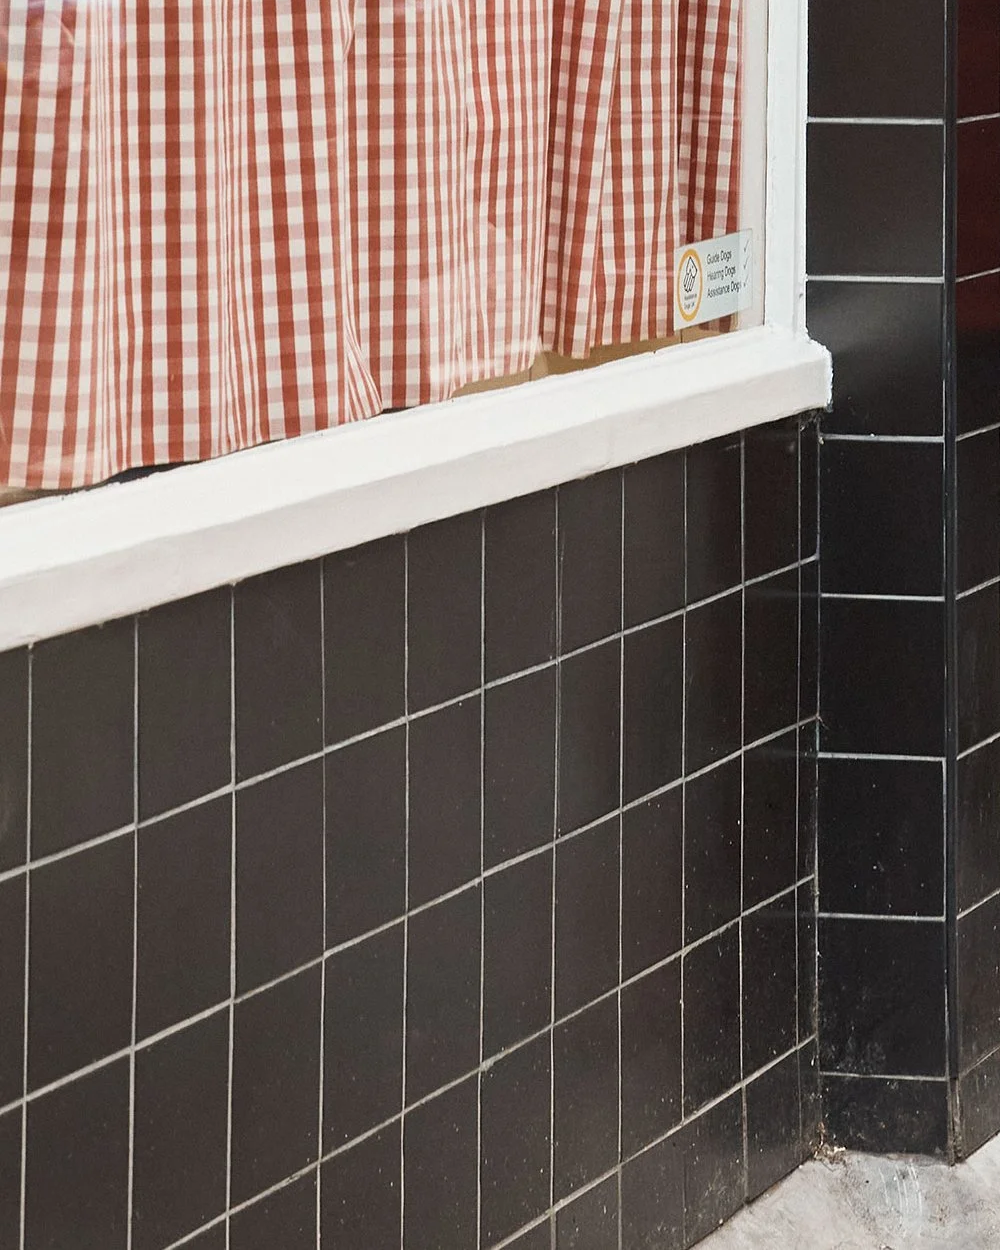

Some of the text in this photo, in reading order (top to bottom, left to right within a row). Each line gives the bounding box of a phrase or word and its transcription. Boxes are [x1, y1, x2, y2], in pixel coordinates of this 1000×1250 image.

[707, 250, 732, 264] Guide Dogs
[706, 266, 736, 281] Hearing Dogs
[707, 285, 730, 298] Assistance
